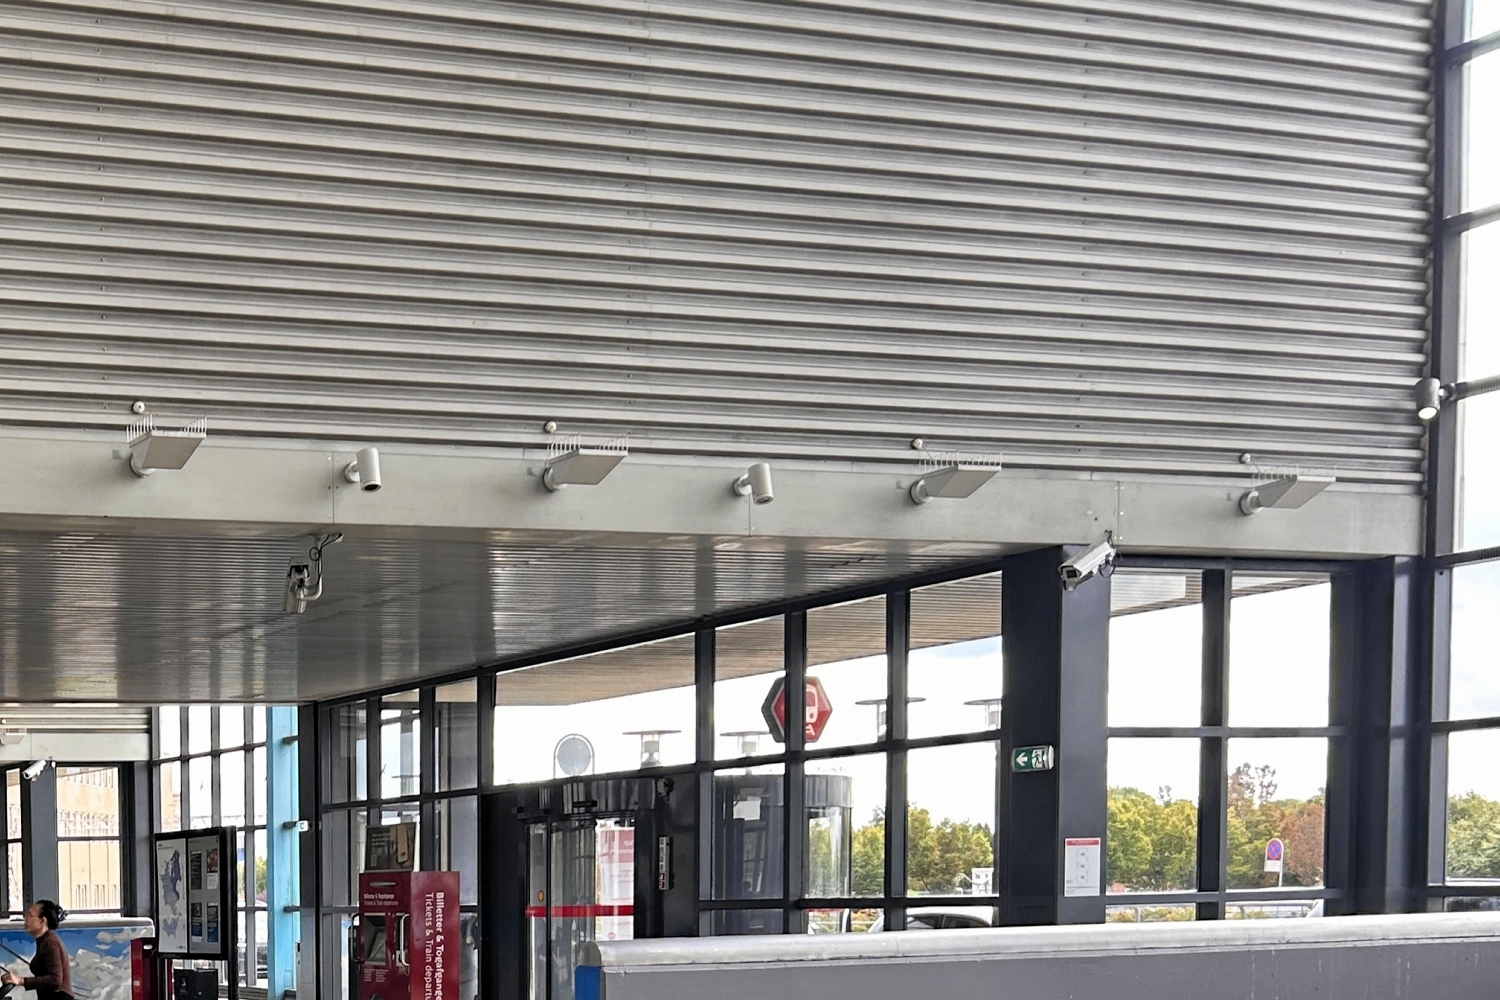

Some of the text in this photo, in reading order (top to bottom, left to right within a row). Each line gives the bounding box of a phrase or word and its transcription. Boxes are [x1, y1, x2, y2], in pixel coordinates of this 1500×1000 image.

[425, 892, 434, 927] Tickets
[435, 892, 444, 933] Billetter
[425, 929, 434, 937] &
[435, 934, 444, 943] &
[425, 940, 434, 963] Train
